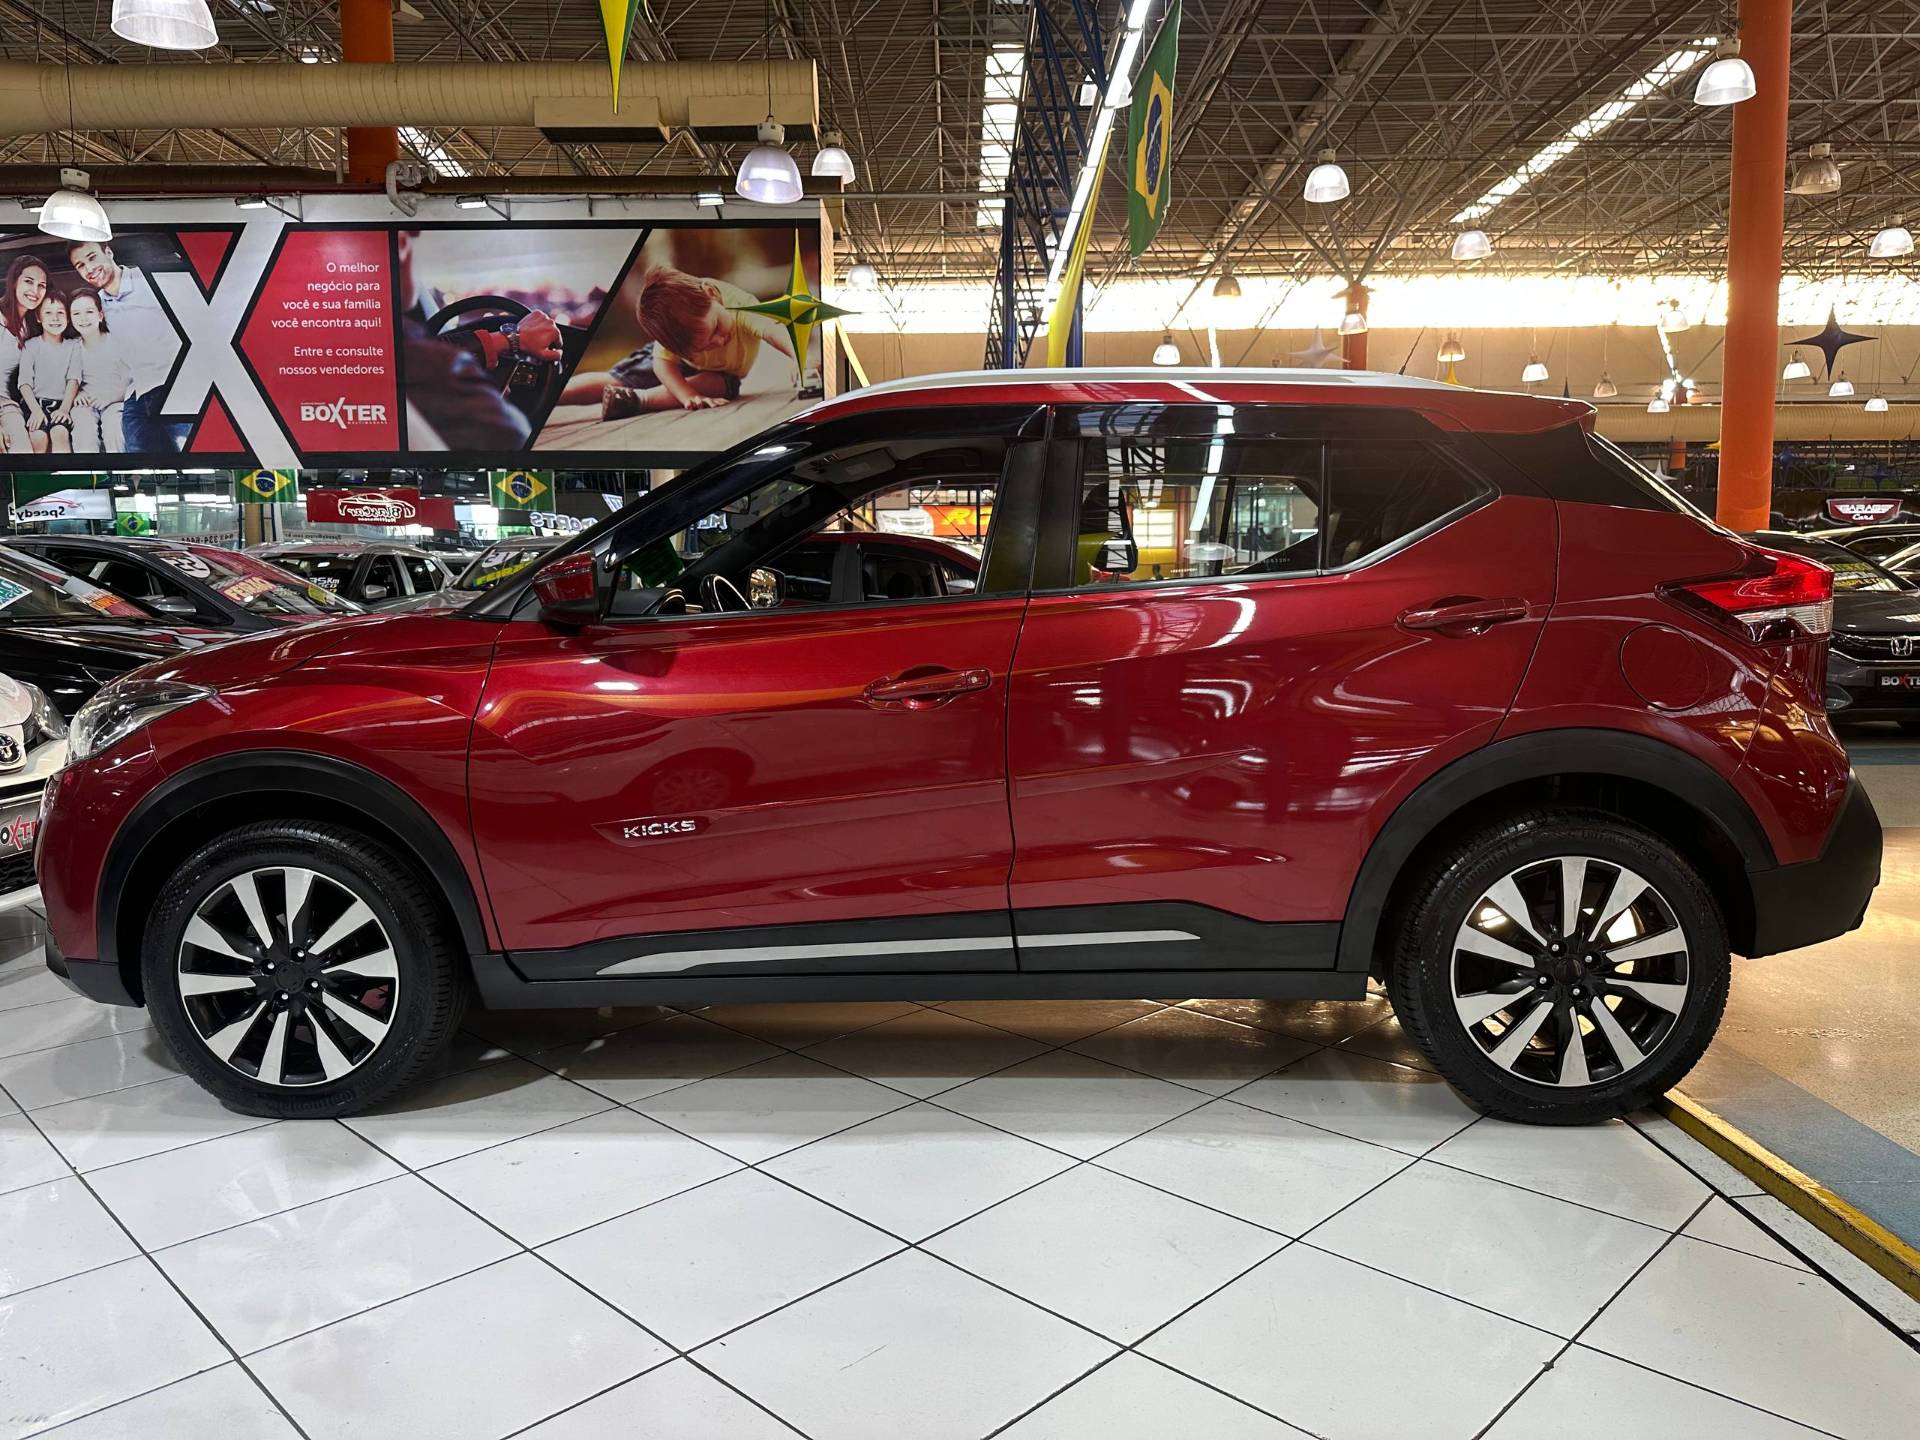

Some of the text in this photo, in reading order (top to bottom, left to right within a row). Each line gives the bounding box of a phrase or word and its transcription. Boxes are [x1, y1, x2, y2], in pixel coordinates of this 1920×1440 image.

[326, 262, 380, 273] O melhor
[307, 281, 380, 294] negócio para
[282, 298, 381, 310] você e sua família
[271, 317, 382, 330] você encontra aqui!
[293, 346, 384, 357] Entre e consulte
[279, 364, 385, 375] nossos vendedores
[300, 397, 387, 429] BOXTER
[623, 820, 696, 838] KICKS
